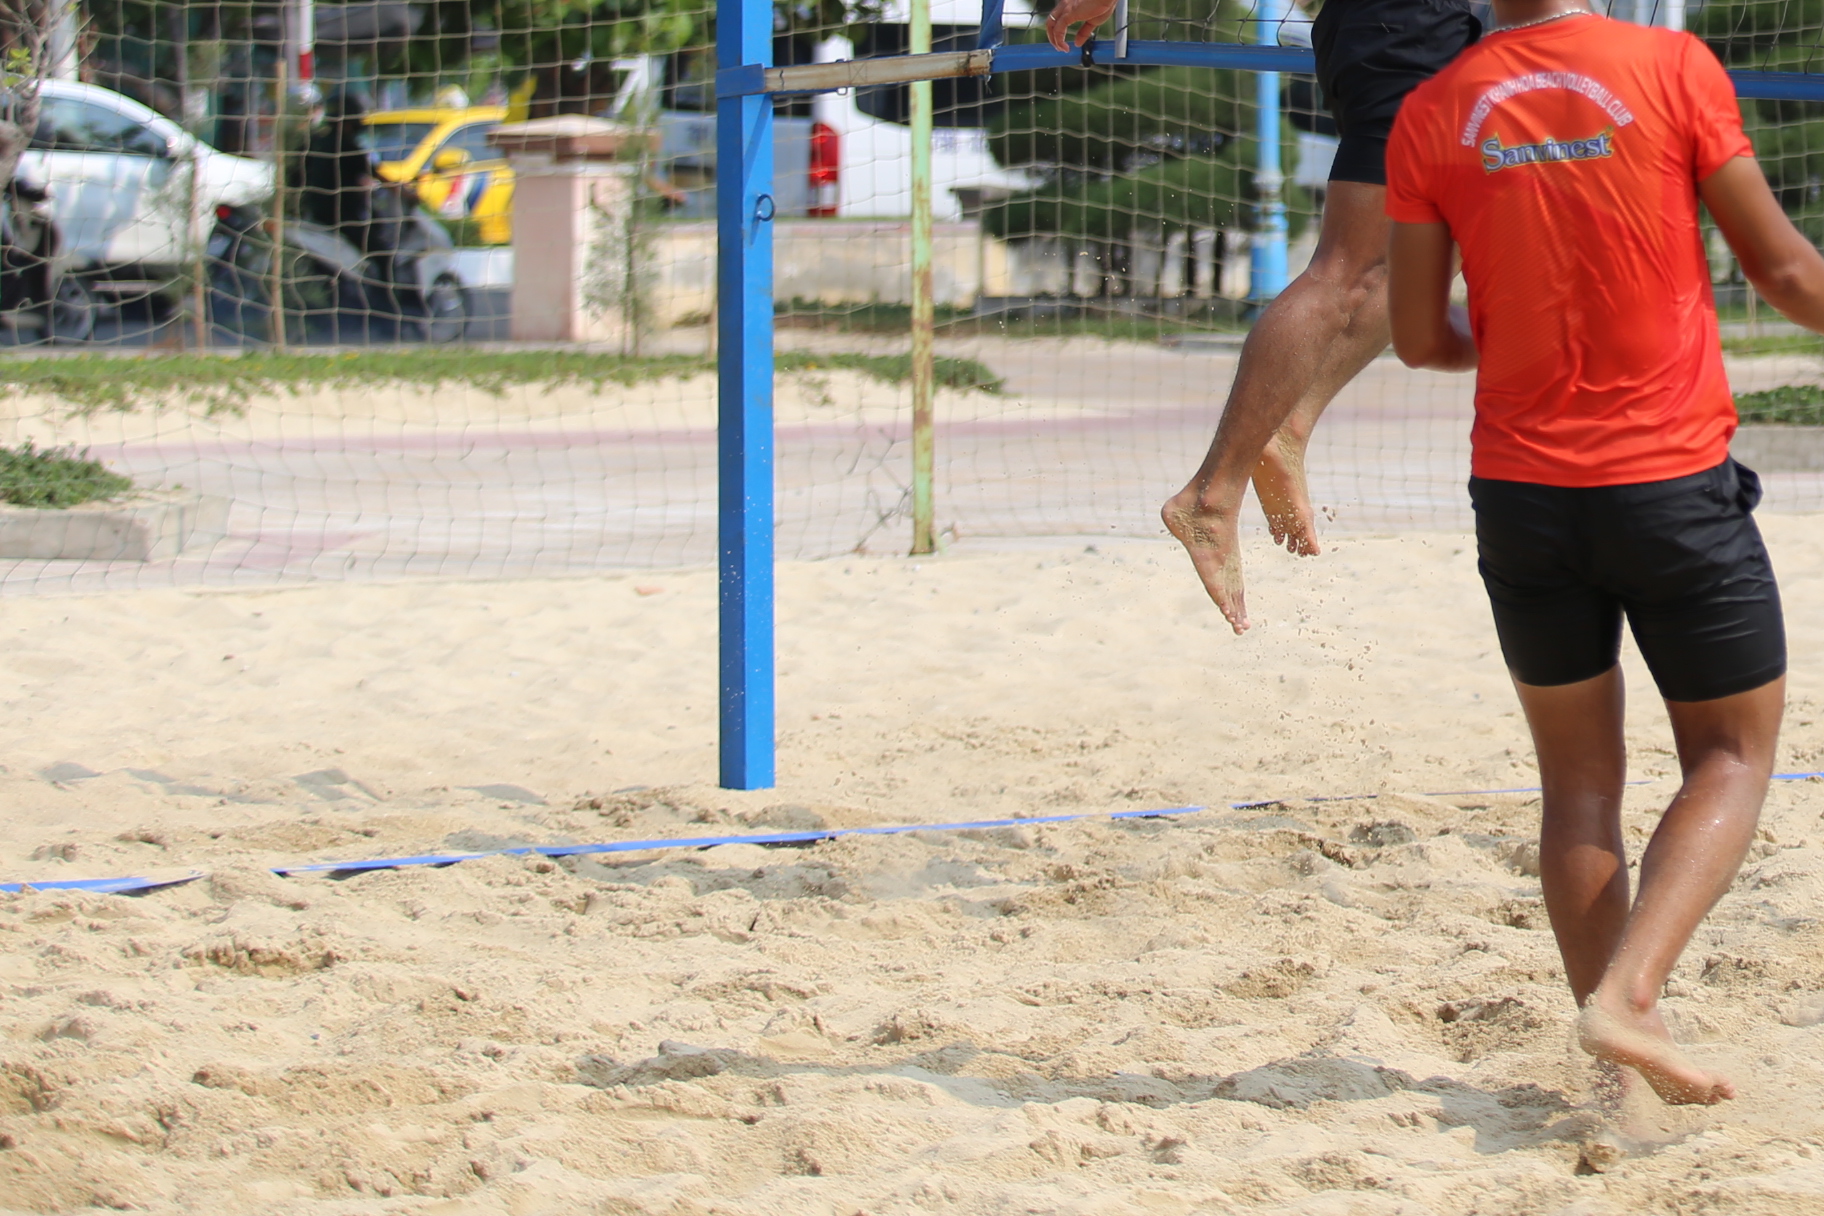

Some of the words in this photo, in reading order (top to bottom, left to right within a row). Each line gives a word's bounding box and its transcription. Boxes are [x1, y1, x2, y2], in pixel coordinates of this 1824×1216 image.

[1562, 71, 1613, 109] VOLLEYBALL
[1606, 99, 1634, 127] CLUB
[1481, 132, 1613, 173] Sanvinest
